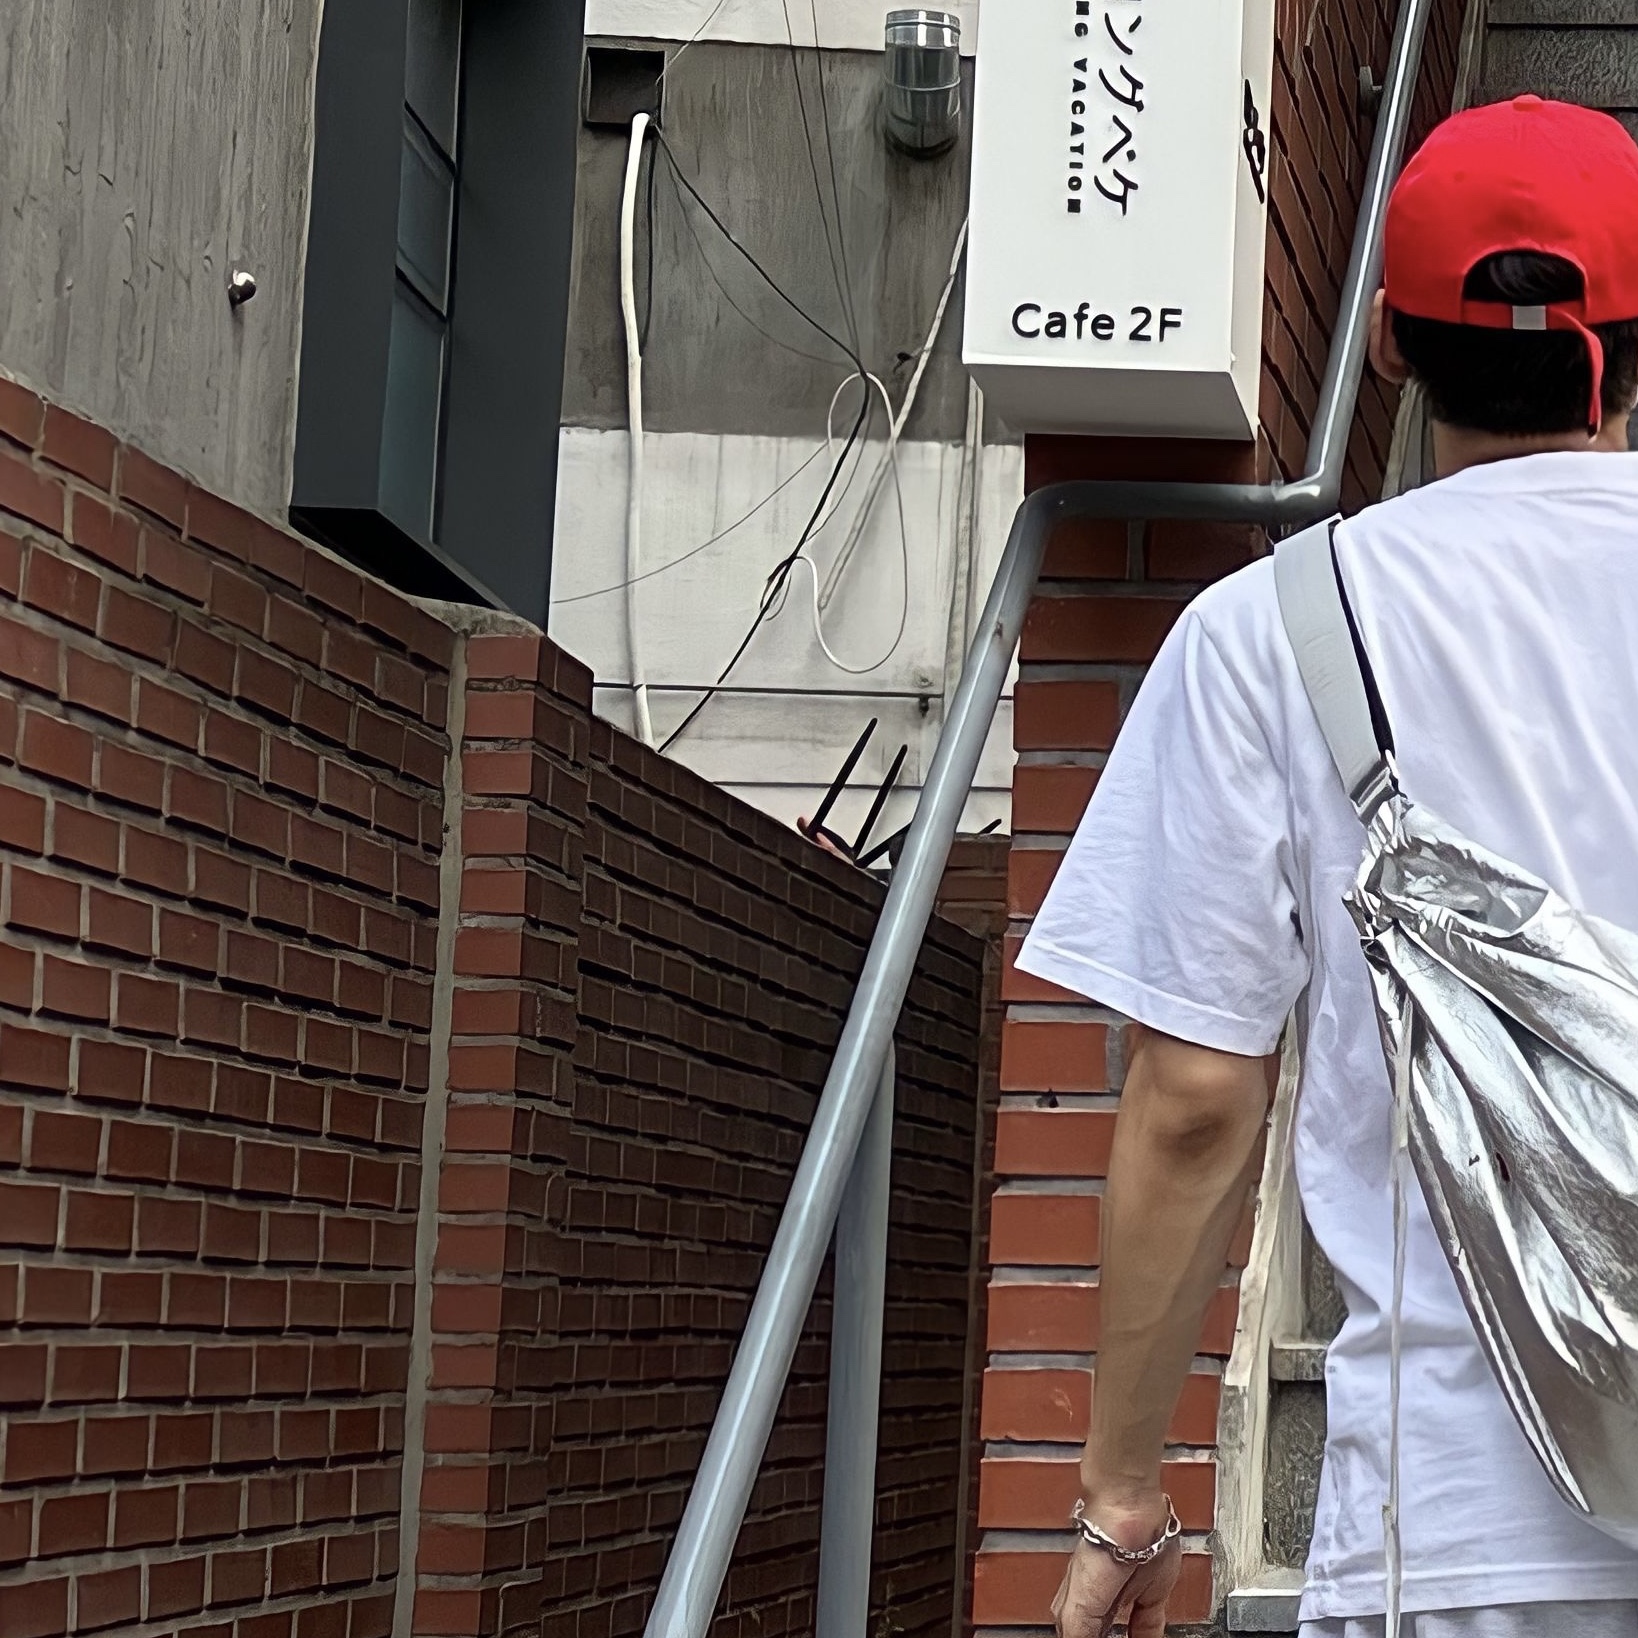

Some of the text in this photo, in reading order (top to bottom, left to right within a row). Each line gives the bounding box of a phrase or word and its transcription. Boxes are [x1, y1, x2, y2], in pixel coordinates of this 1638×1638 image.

[1067, 57, 1088, 214] VACATION
[1011, 302, 1183, 343] Cafe 2F
